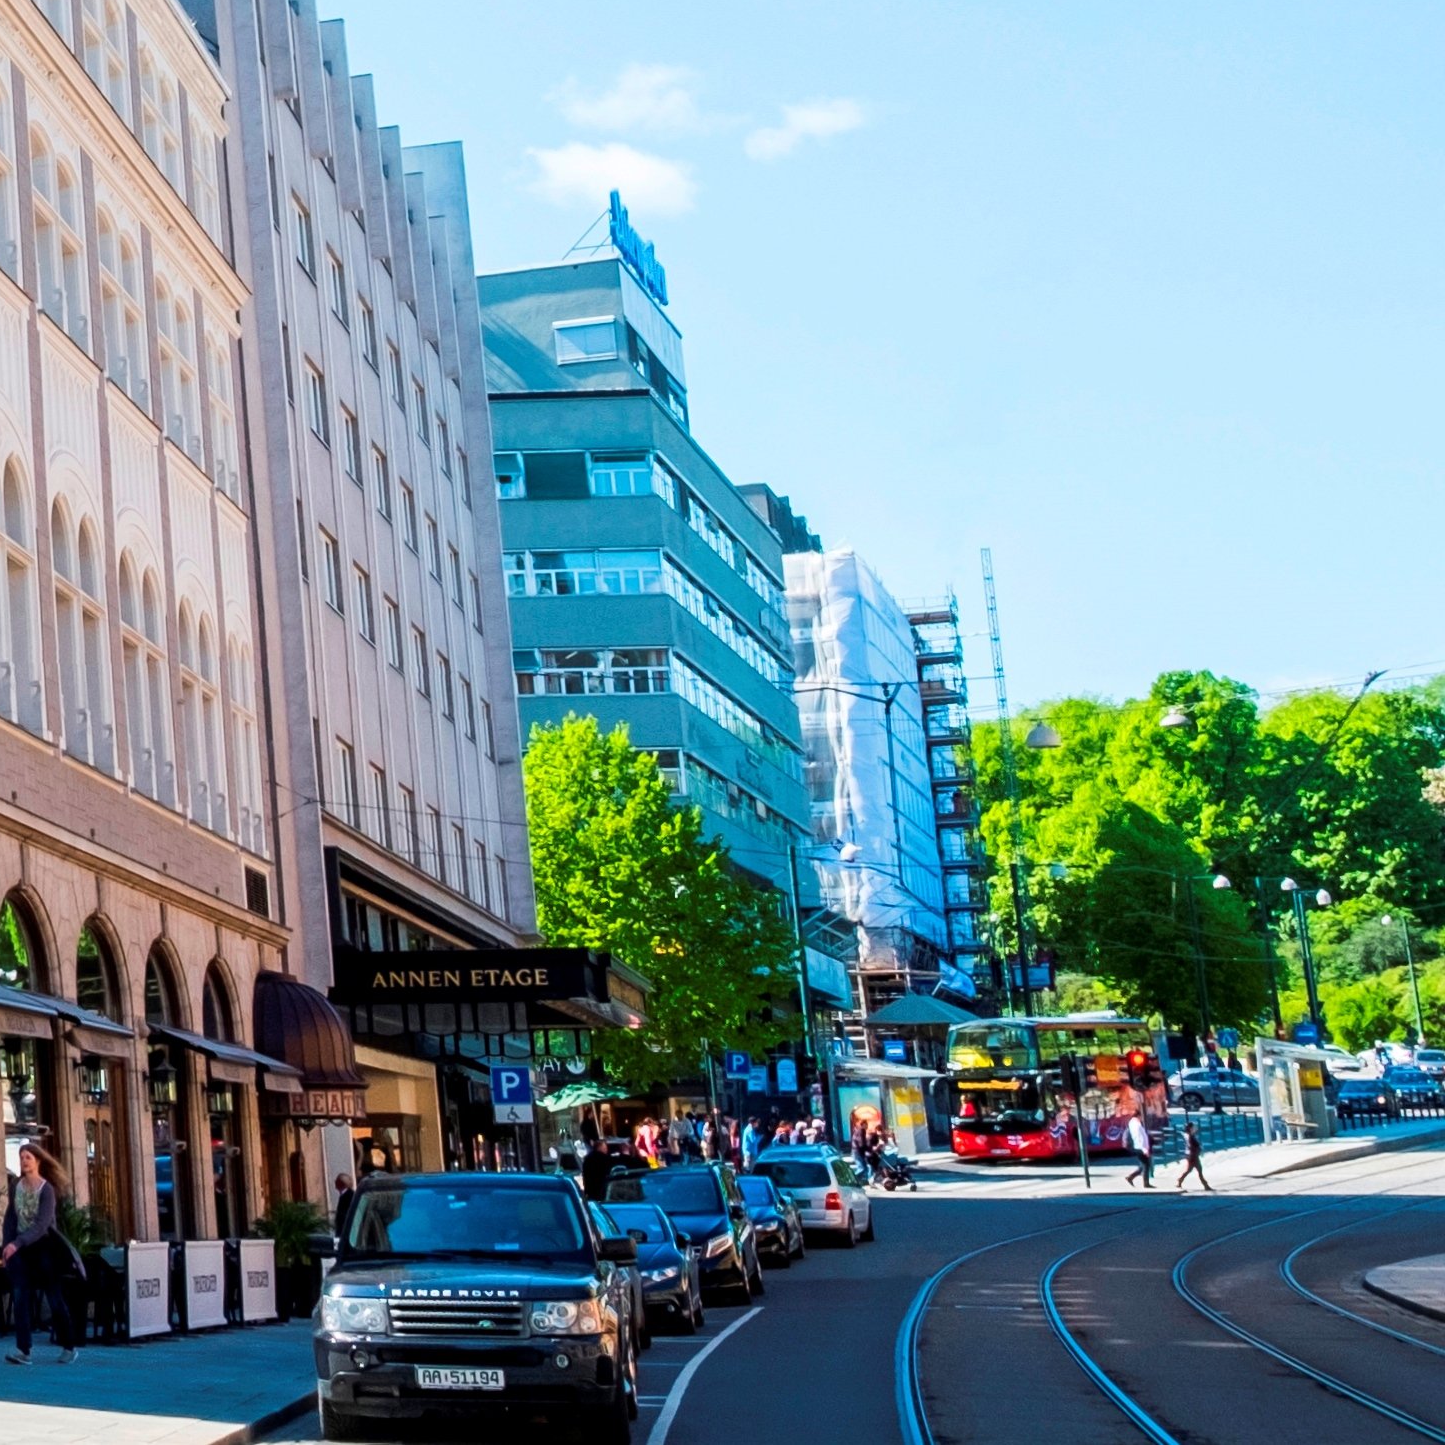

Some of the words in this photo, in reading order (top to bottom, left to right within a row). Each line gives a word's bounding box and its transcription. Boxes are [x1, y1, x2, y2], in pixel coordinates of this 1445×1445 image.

[372, 969, 460, 988] ANNEN
[470, 968, 549, 987] ETAGE
[500, 1071, 521, 1100] P
[391, 1288, 452, 1297] RANGE
[458, 1289, 520, 1298] ROVER
[450, 1370, 499, 1385] 51194
